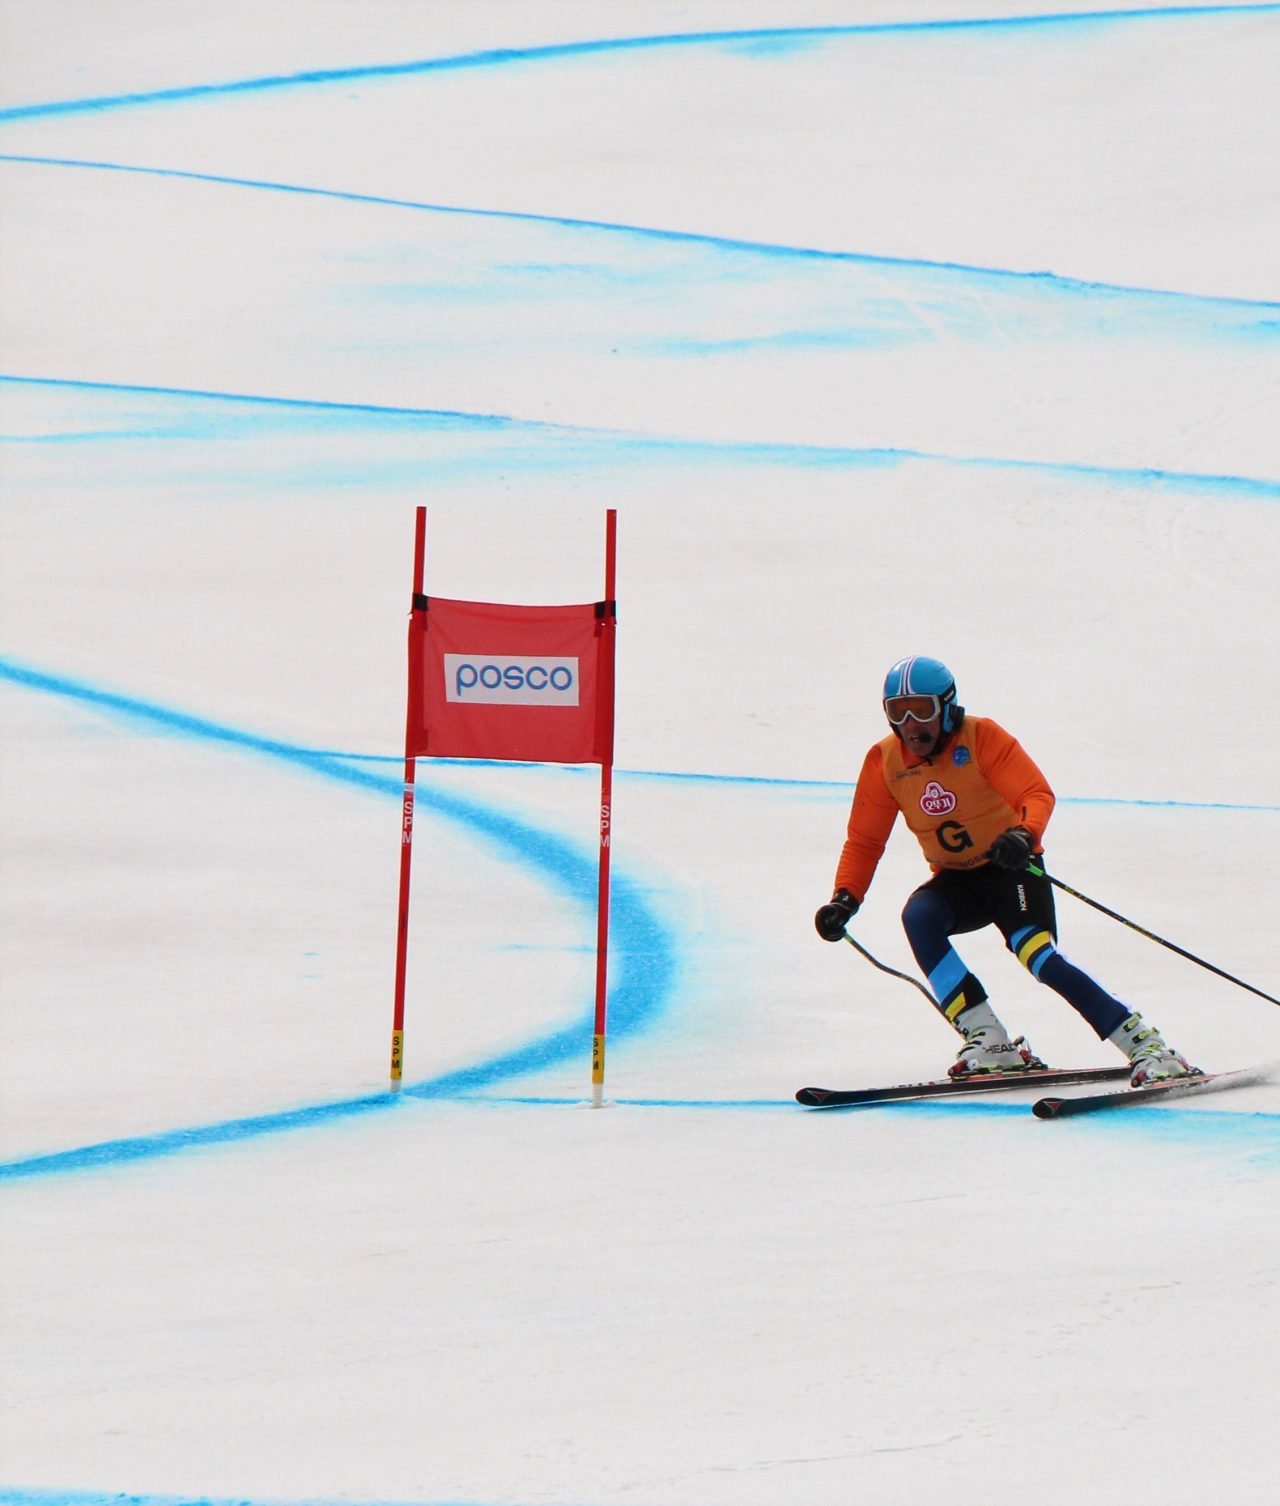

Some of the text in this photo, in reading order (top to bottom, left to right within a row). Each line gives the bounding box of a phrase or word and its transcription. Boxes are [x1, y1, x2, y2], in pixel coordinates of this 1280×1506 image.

[456, 663, 573, 696] posco
[402, 801, 413, 844] SPM
[600, 805, 610, 848] SPM
[936, 820, 974, 853] G
